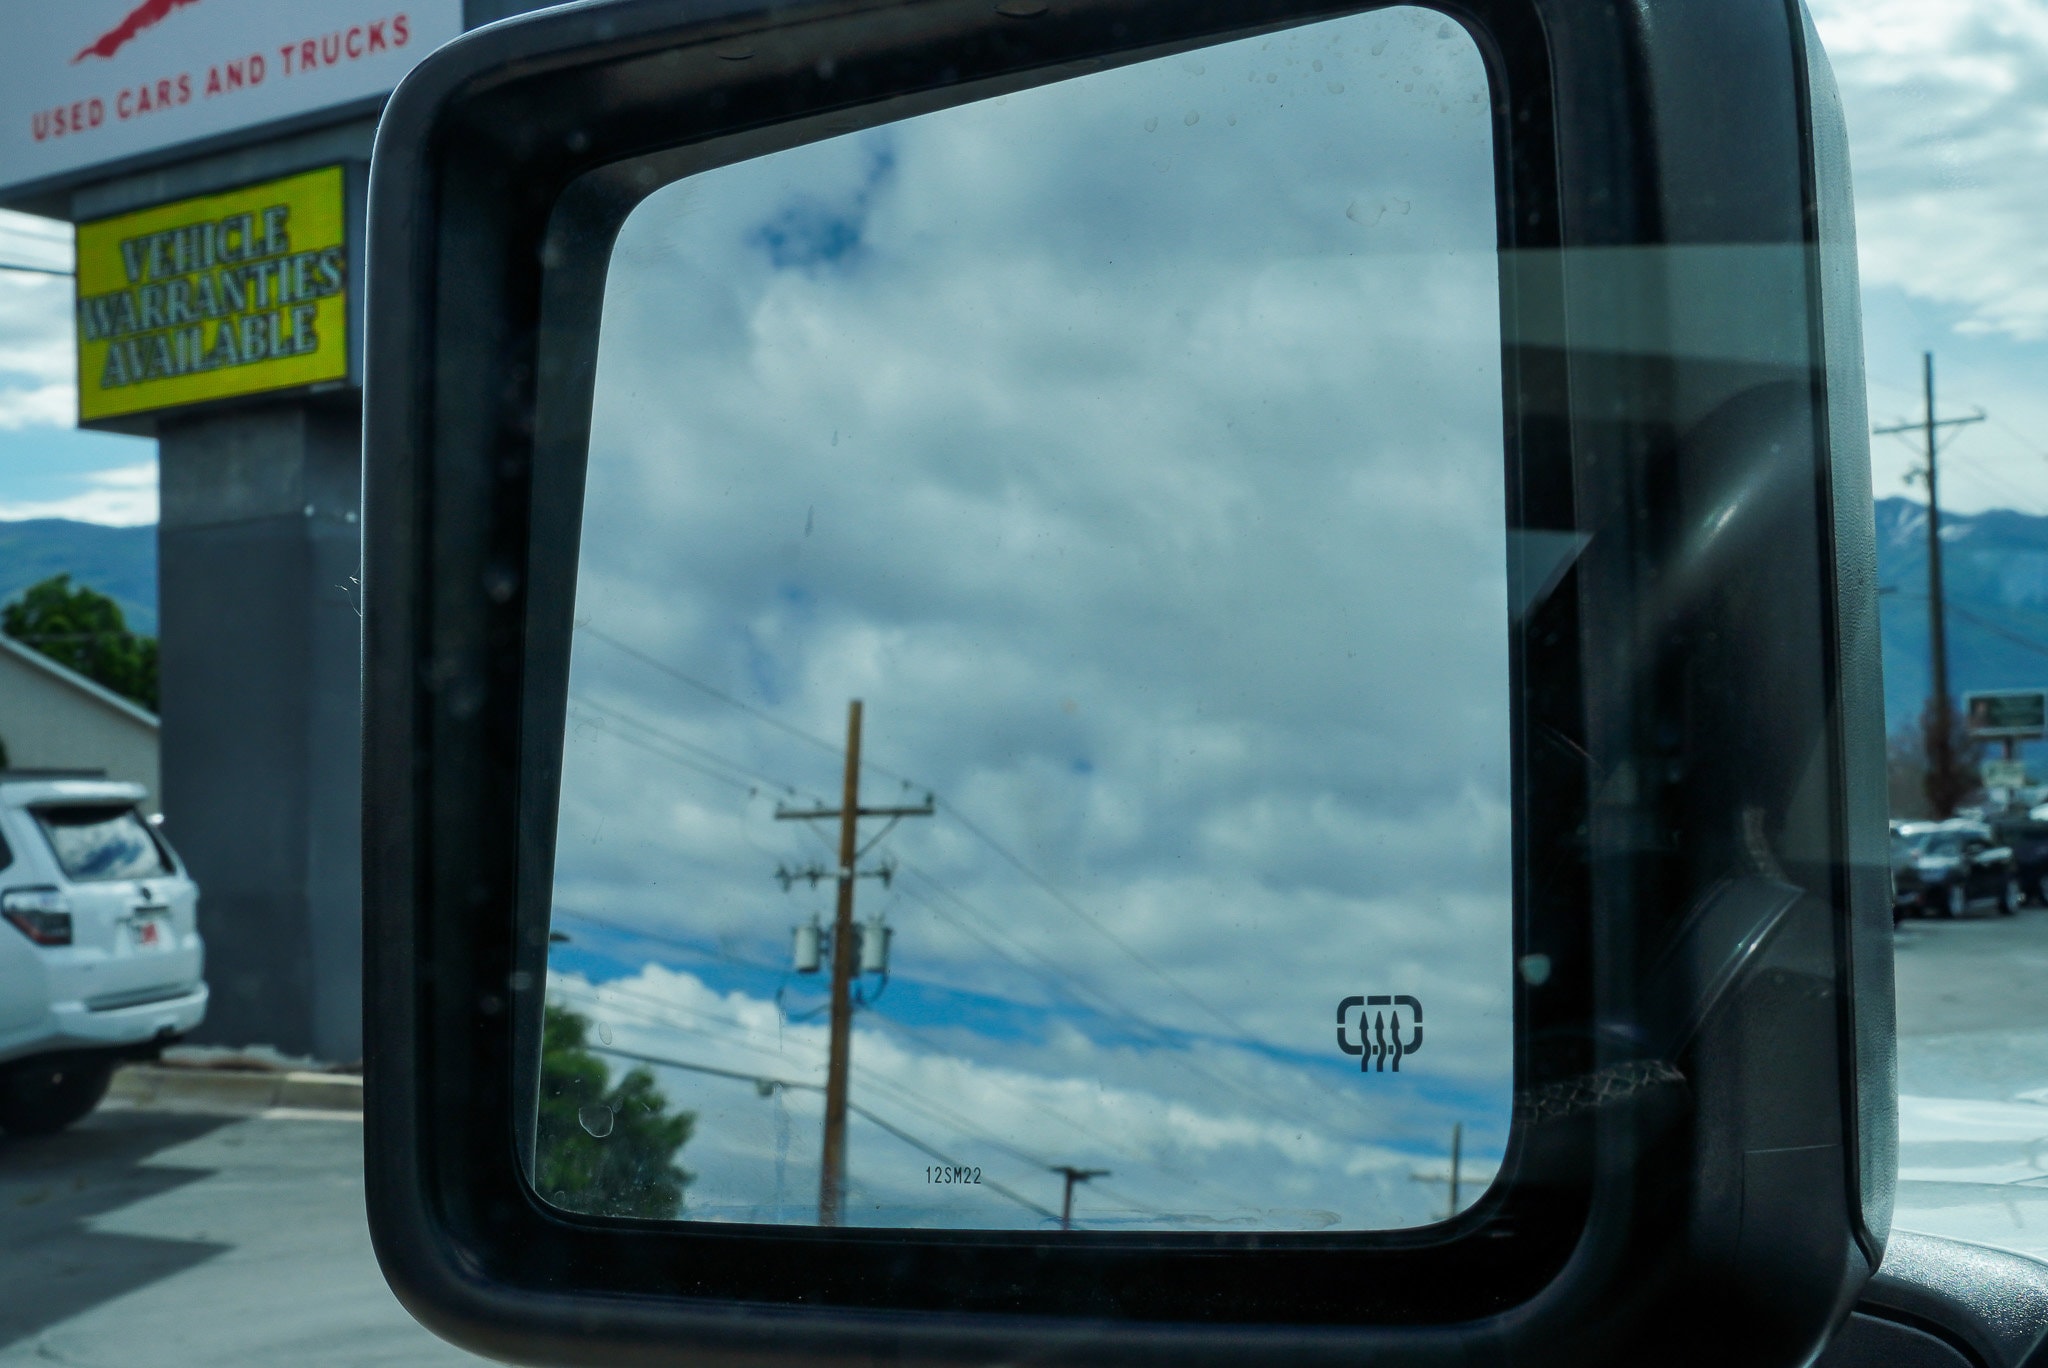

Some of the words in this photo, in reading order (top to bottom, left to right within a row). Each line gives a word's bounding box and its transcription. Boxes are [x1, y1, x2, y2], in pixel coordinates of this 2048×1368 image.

[32, 99, 103, 142] USED
[116, 74, 193, 121] CARS
[206, 57, 266, 97] AND
[281, 14, 411, 76] TRUCKS
[119, 203, 290, 284] VEHICLE
[79, 246, 345, 341] WARRANTIES
[102, 304, 317, 389] AVAILABLE
[926, 1166, 981, 1184] 12SM22
